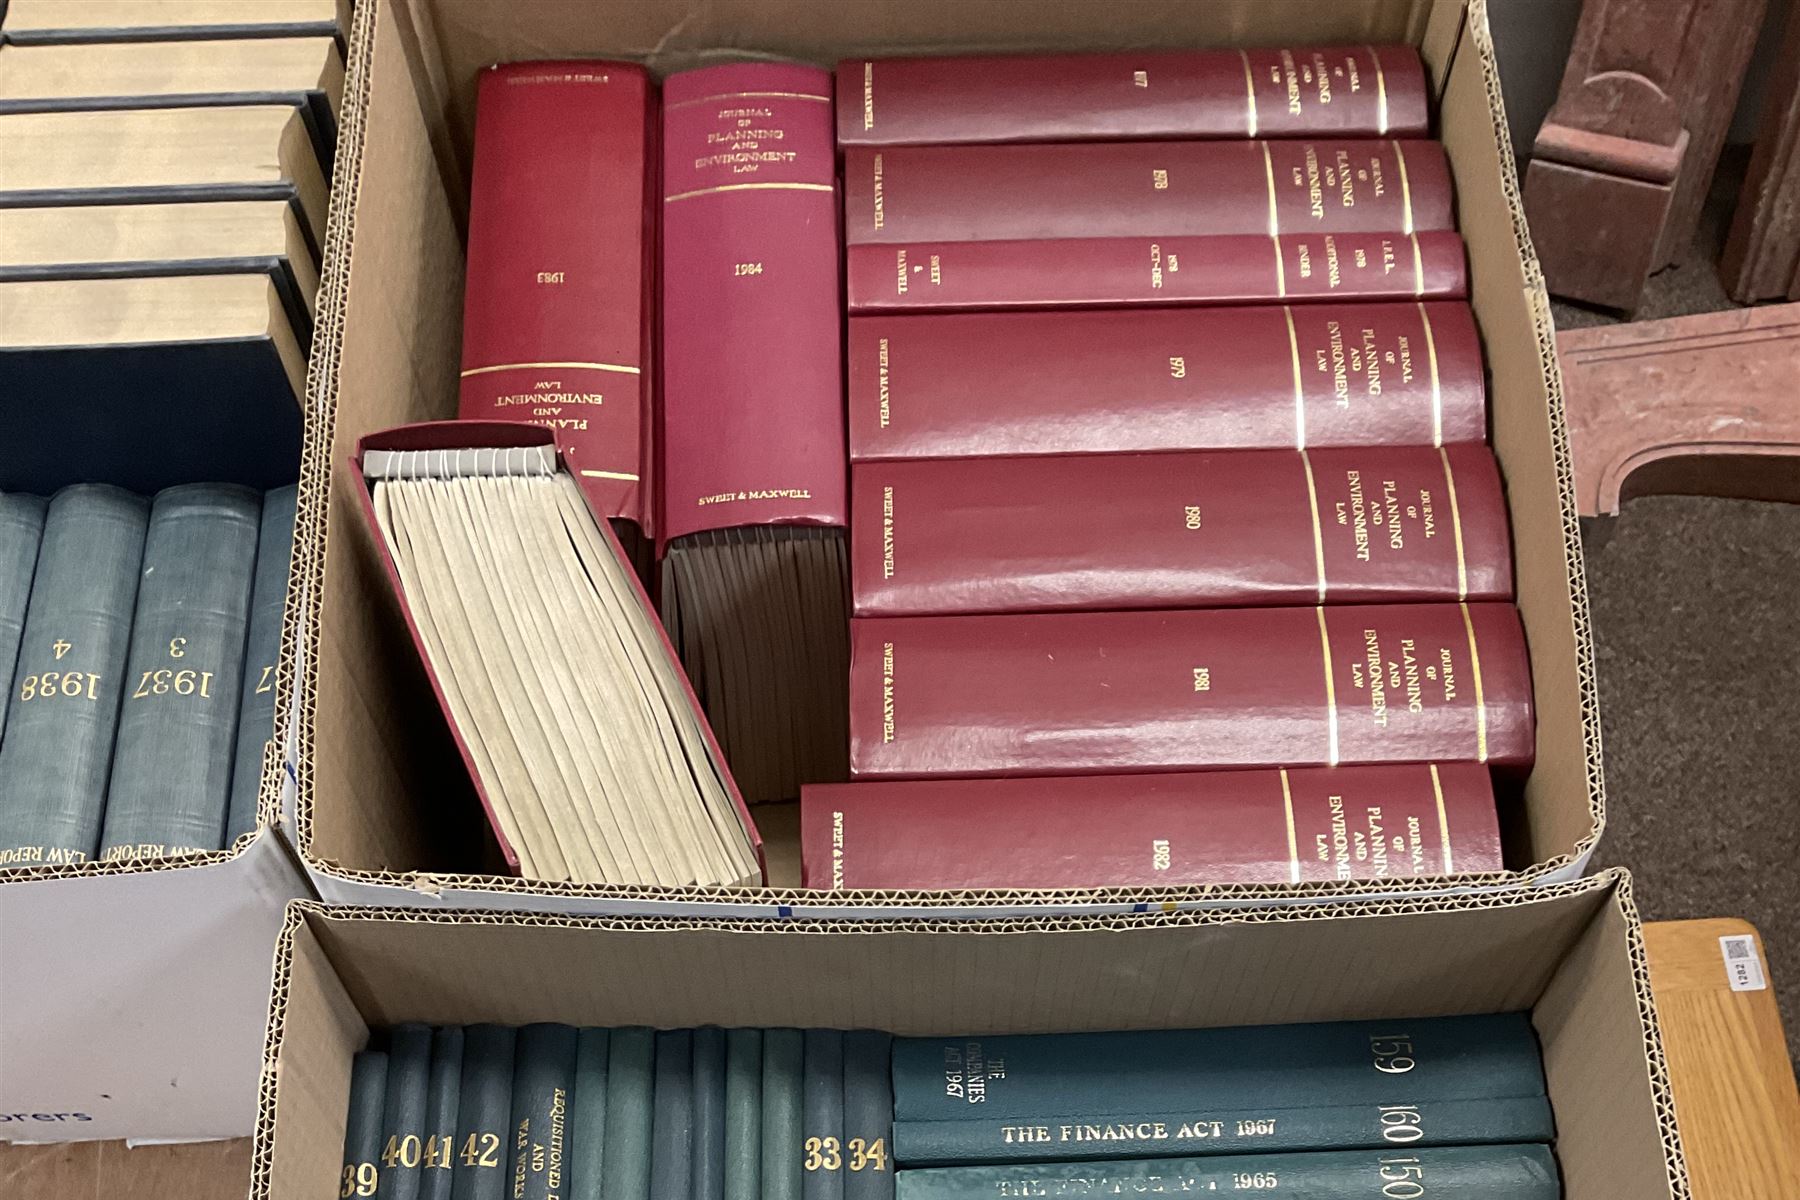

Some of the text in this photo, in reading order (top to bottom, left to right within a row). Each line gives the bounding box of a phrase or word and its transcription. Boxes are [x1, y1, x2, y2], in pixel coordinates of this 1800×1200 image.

[707, 130, 784, 144] PLANNING
[731, 141, 759, 150] AND
[695, 151, 797, 169] ENVIRONMENT
[733, 164, 759, 173] LAW
[1293, 167, 1303, 186] LAW
[1325, 166, 1335, 186] AND
[1336, 150, 1354, 207] PLANNING
[536, 272, 565, 284] 1983
[734, 263, 763, 276] 1984
[897, 250, 908, 294] MAXWELL
[1170, 357, 1186, 378] 1979
[1316, 349, 1328, 372] LAW
[1327, 321, 1349, 409] ENVIRONMENT
[1351, 348, 1362, 371] AND
[1362, 328, 1382, 396] PLANNING
[1385, 350, 1395, 364] OF
[1398, 335, 1413, 384] JOURNAL
[494, 393, 603, 406] ENVIRONMENT
[534, 381, 562, 390] LAW
[533, 407, 561, 416] AND
[880, 377, 890, 428] MAXWELL
[698, 488, 812, 506] SWEET MAXWELL
[1407, 505, 1416, 519] OF
[1185, 505, 1201, 530] 1980
[1335, 502, 1347, 526] LAW
[1346, 470, 1370, 562] ENVIRONMENT
[1371, 501, 1383, 526] AND
[1382, 480, 1403, 550] PLANNING
[1420, 489, 1435, 539] JOURNAL
[884, 486, 894, 579] SWEET MAXWELL
[53, 638, 72, 660] 4
[169, 638, 187, 658] 3
[20, 672, 101, 701] 1938
[133, 669, 214, 700] 1937
[1193, 667, 1210, 692] 1981
[1352, 663, 1363, 689] LAW
[1364, 628, 1388, 727] ENVIRONMENT
[1388, 661, 1401, 689] AND
[1401, 638, 1424, 714] PLANNING
[1426, 666, 1436, 681] OF
[1440, 647, 1456, 701] JOURNAL
[884, 642, 894, 743] SWEET MAXWELL
[833, 812, 844, 847] SWEET
[1328, 795, 1352, 880] ENVIRONME
[1367, 806, 1389, 877] PLANNIN
[1393, 836, 1404, 852] OF
[1407, 815, 1425, 874] JOURNAL
[1153, 839, 1170, 871] 1982
[1316, 833, 1329, 861] LAW
[1354, 831, 1367, 861] AND
[1370, 1035, 1415, 1073] 159
[946, 1069, 964, 1099] 1967
[548, 1087, 566, 1188] REQUISITIONED
[1000, 1119, 1276, 1143] THE FINANCE ACT 1967
[1377, 1105, 1424, 1142] 160
[382, 1135, 421, 1168] 40
[423, 1135, 452, 1169] 41
[460, 1134, 499, 1168] 42
[514, 1118, 529, 1199] WAR WORKS
[532, 1143, 545, 1171] AND
[804, 1136, 841, 1171] 33
[849, 1137, 888, 1171] 34
[341, 1163, 378, 1198] 39
[1233, 1173, 1278, 1189] 1965
[1377, 1156, 1424, 1199] 150
